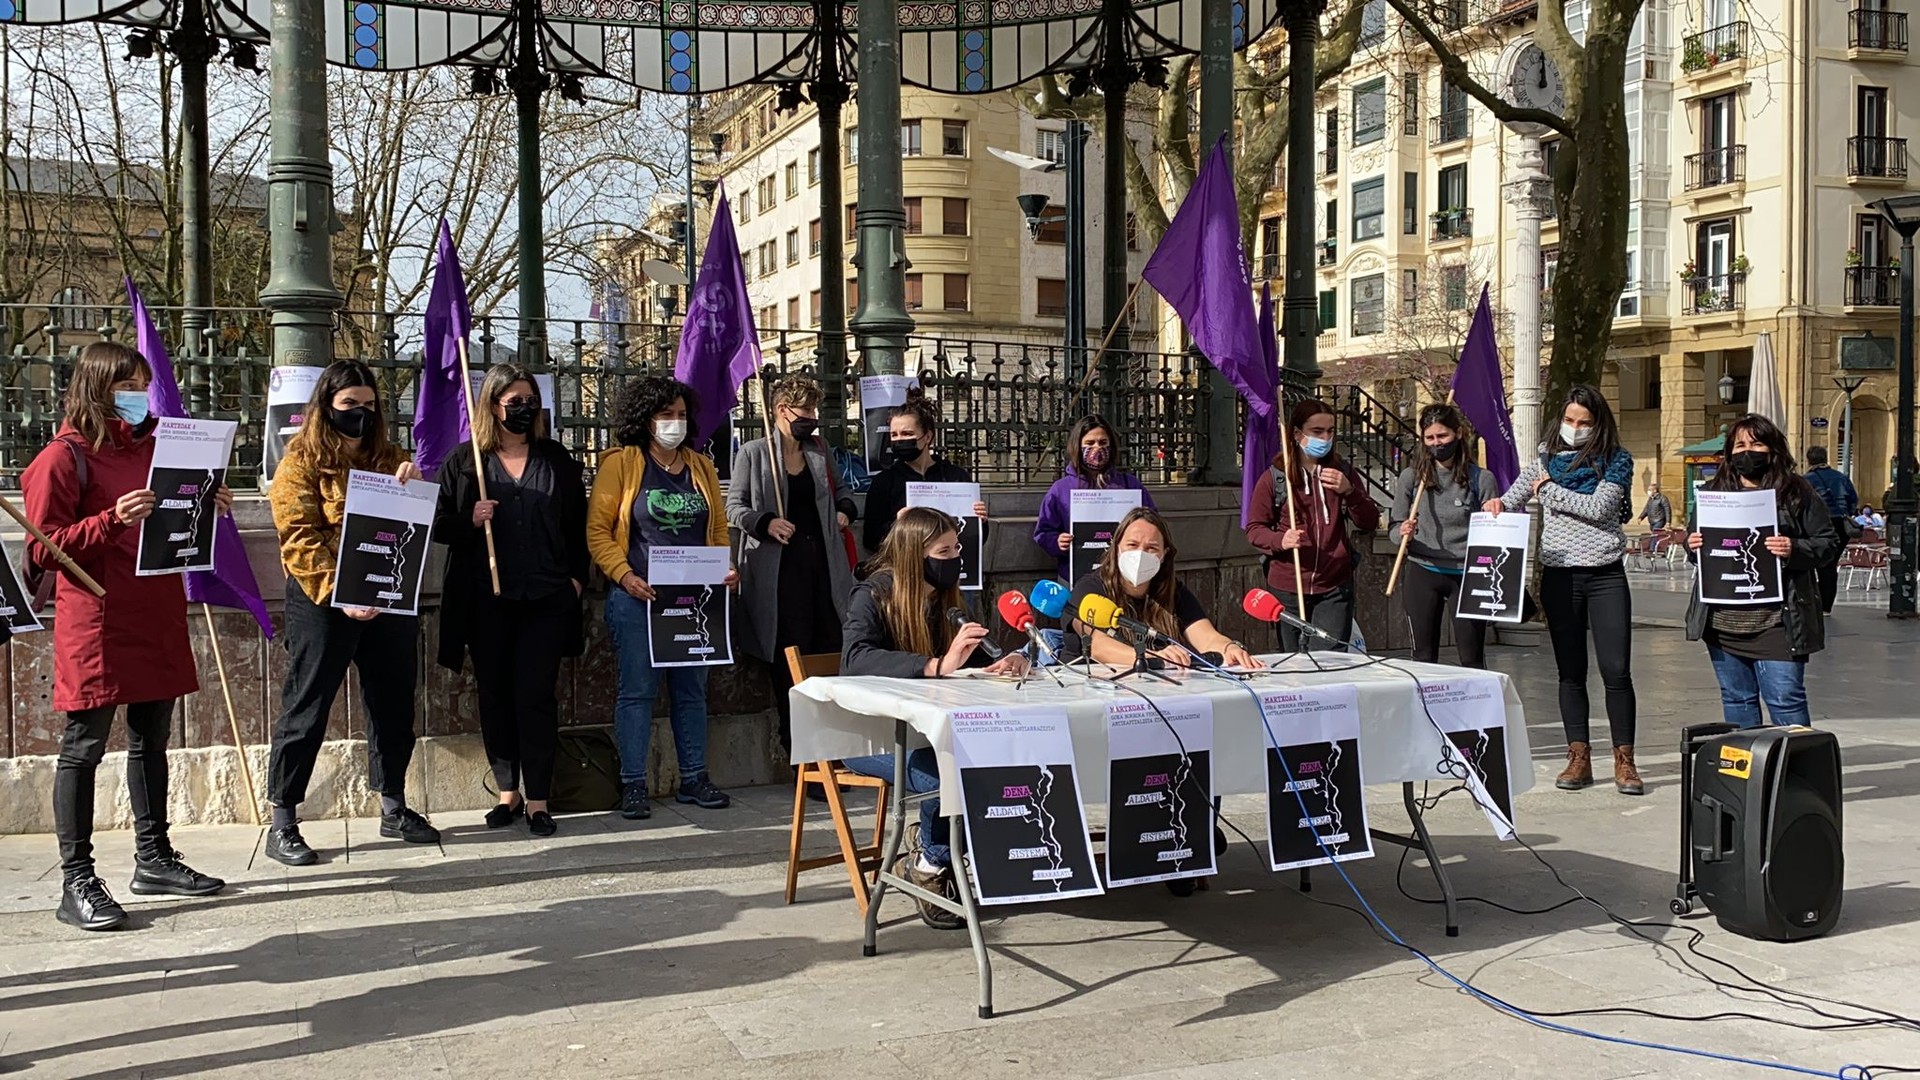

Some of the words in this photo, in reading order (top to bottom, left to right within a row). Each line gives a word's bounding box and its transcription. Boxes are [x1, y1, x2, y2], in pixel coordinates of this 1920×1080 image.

[352, 474, 385, 484] MARTXOAK
[360, 544, 389, 553] ALDATU
[1417, 685, 1445, 693] MRTXOAK
[1264, 695, 1298, 704] MARTXOAK
[1110, 704, 1145, 713] MARTXOAK
[953, 712, 993, 720] MARTXOAK
[1300, 762, 1322, 772] DENA
[1146, 775, 1169, 785] DENA
[1285, 780, 1316, 790] ADATU
[1004, 787, 1031, 797] DENA
[1129, 794, 1162, 804] ALDATU
[989, 807, 1025, 817] ALDATU
[1141, 831, 1175, 841] SISTEMA
[1010, 848, 1048, 859] SISTEMA
